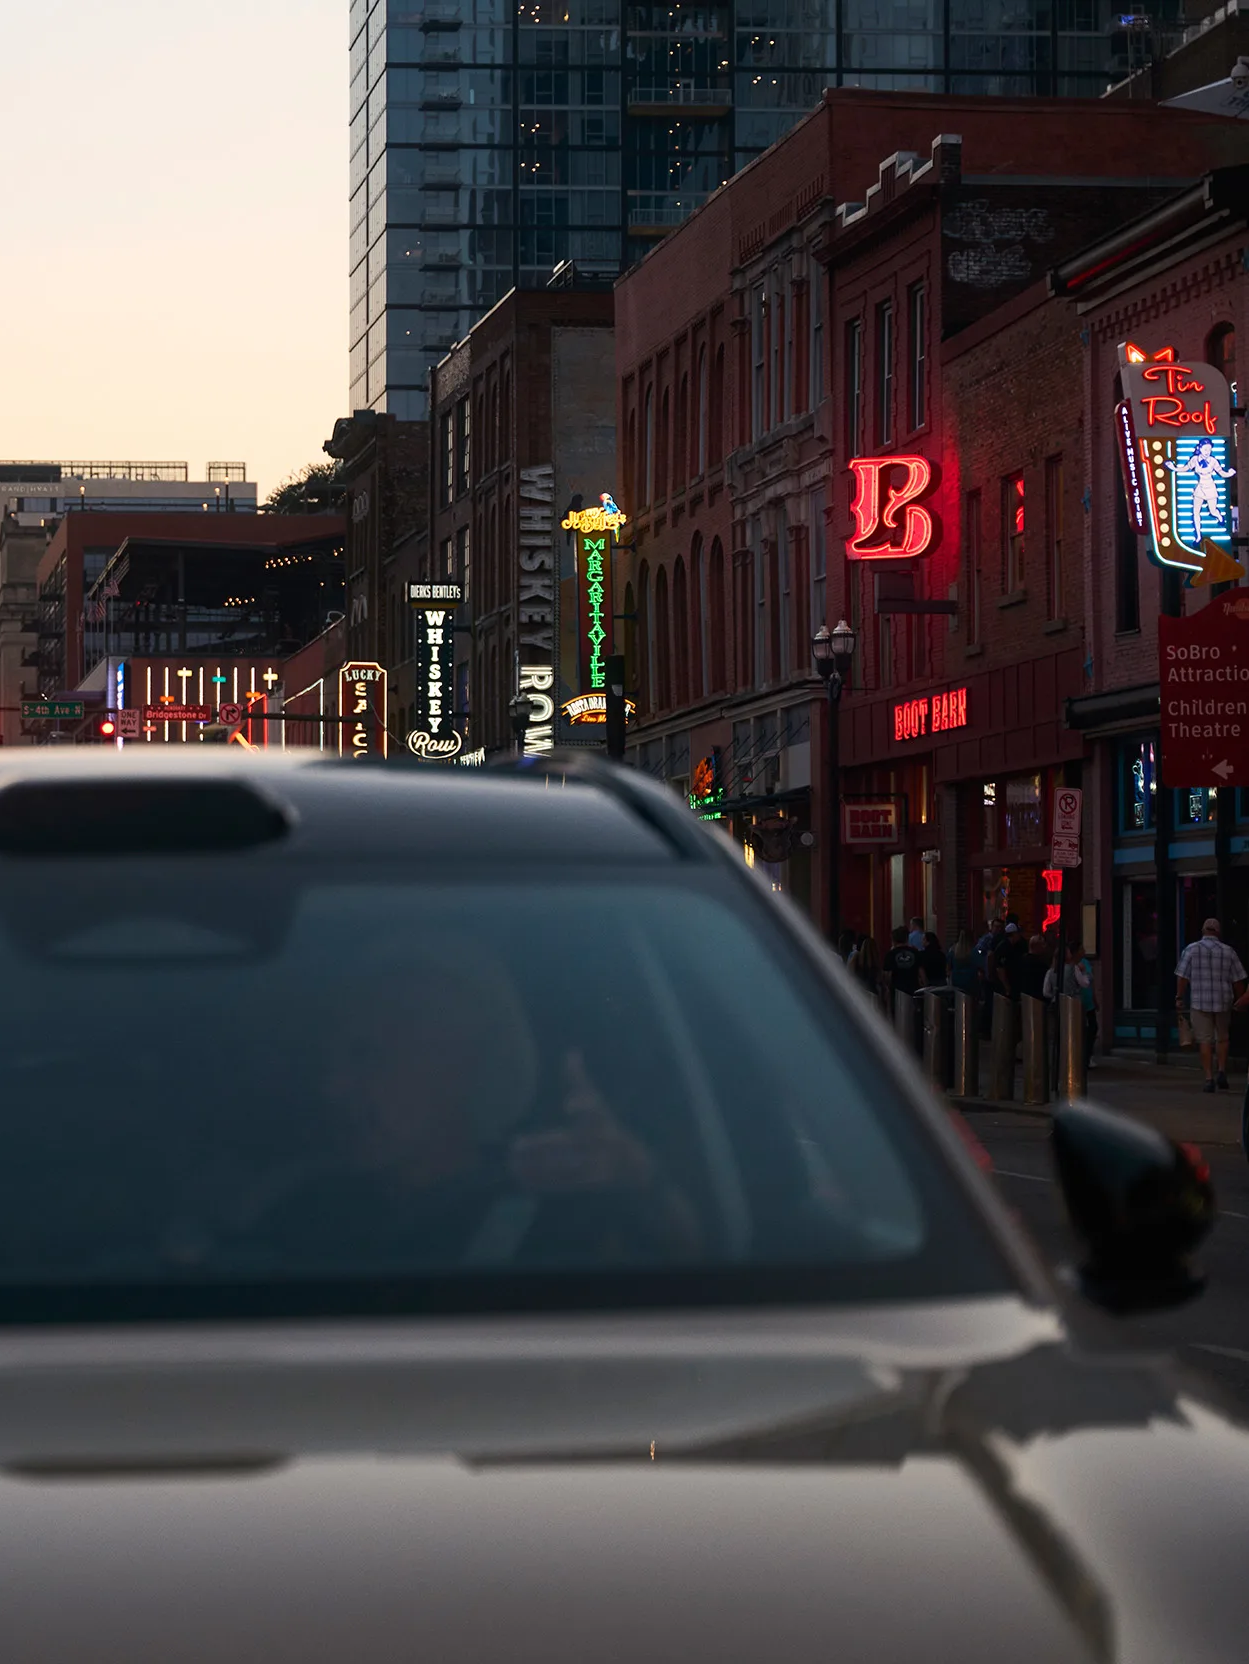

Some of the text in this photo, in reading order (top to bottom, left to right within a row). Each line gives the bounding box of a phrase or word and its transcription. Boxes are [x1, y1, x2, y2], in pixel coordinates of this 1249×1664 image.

[1143, 365, 1205, 395] Tin
[1140, 396, 1218, 435] Roof
[1127, 447, 1138, 486] MUSIC
[1133, 488, 1144, 527] JOINT
[410, 585, 431, 599] DIERKS
[519, 466, 554, 757] WHISKEY ROW
[583, 538, 607, 688] MARGARITAVILLE
[1166, 645, 1221, 660] SoBro
[344, 669, 382, 682] LUCKY
[424, 610, 446, 733] WHISKEY
[1168, 664, 1249, 683] Attractio
[54, 705, 70, 715] Ave
[146, 711, 197, 720] Bridgestone
[566, 697, 606, 717] RESTAURAN
[894, 687, 967, 741] BOOT BARN
[1168, 700, 1248, 716] Children
[1168, 721, 1242, 738] Theatre
[412, 731, 457, 756] Row
[850, 809, 892, 823] BOOT
[850, 824, 892, 838] BARN
